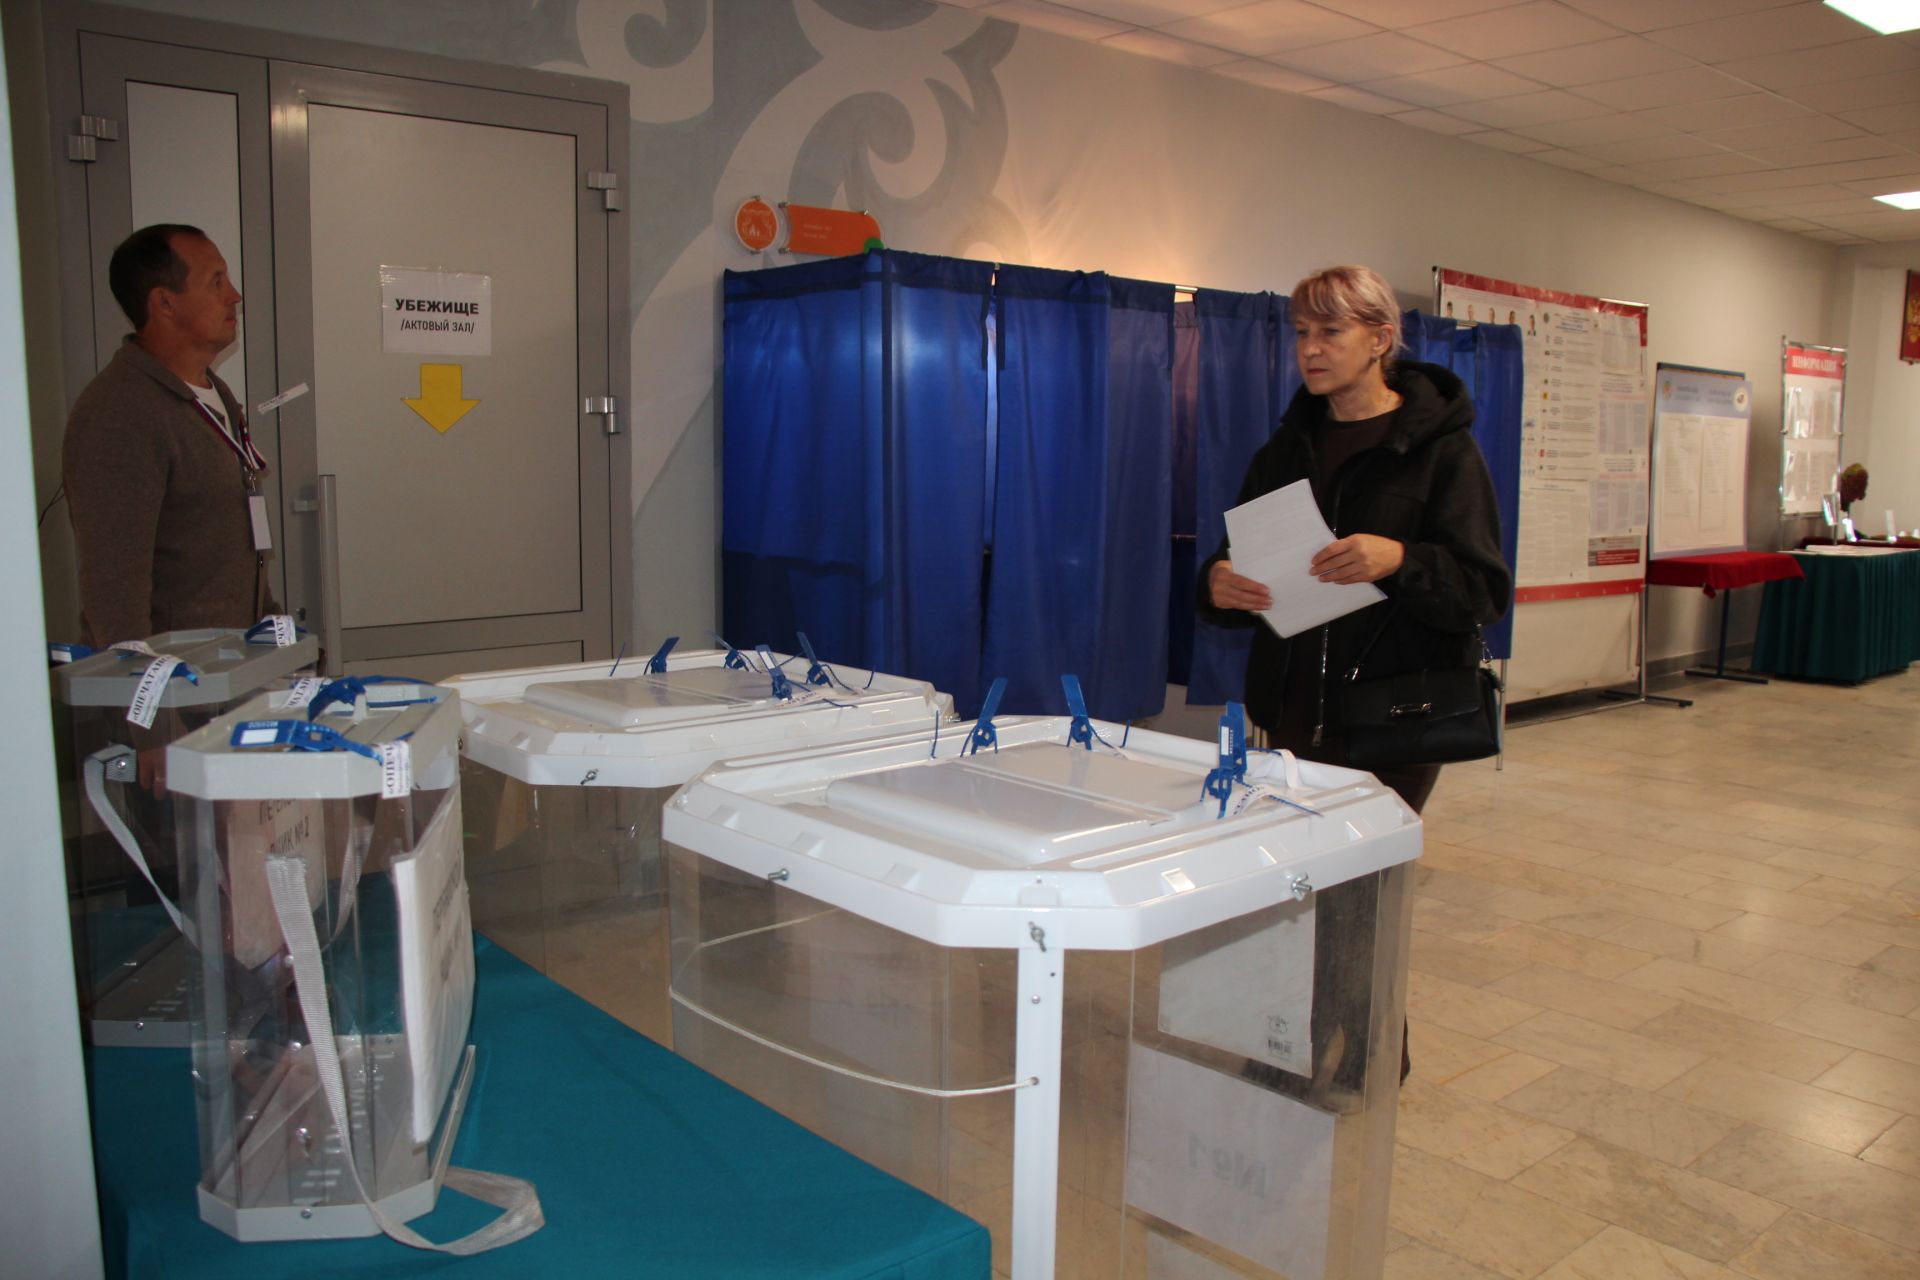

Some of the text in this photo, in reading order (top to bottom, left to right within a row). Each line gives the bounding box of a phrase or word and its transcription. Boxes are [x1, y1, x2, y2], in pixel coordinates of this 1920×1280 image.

[395, 298, 479, 317] УБЕЖИЩЕ
[400, 319, 475, 334] /АКТОВЫЙ ЗАЛ/
